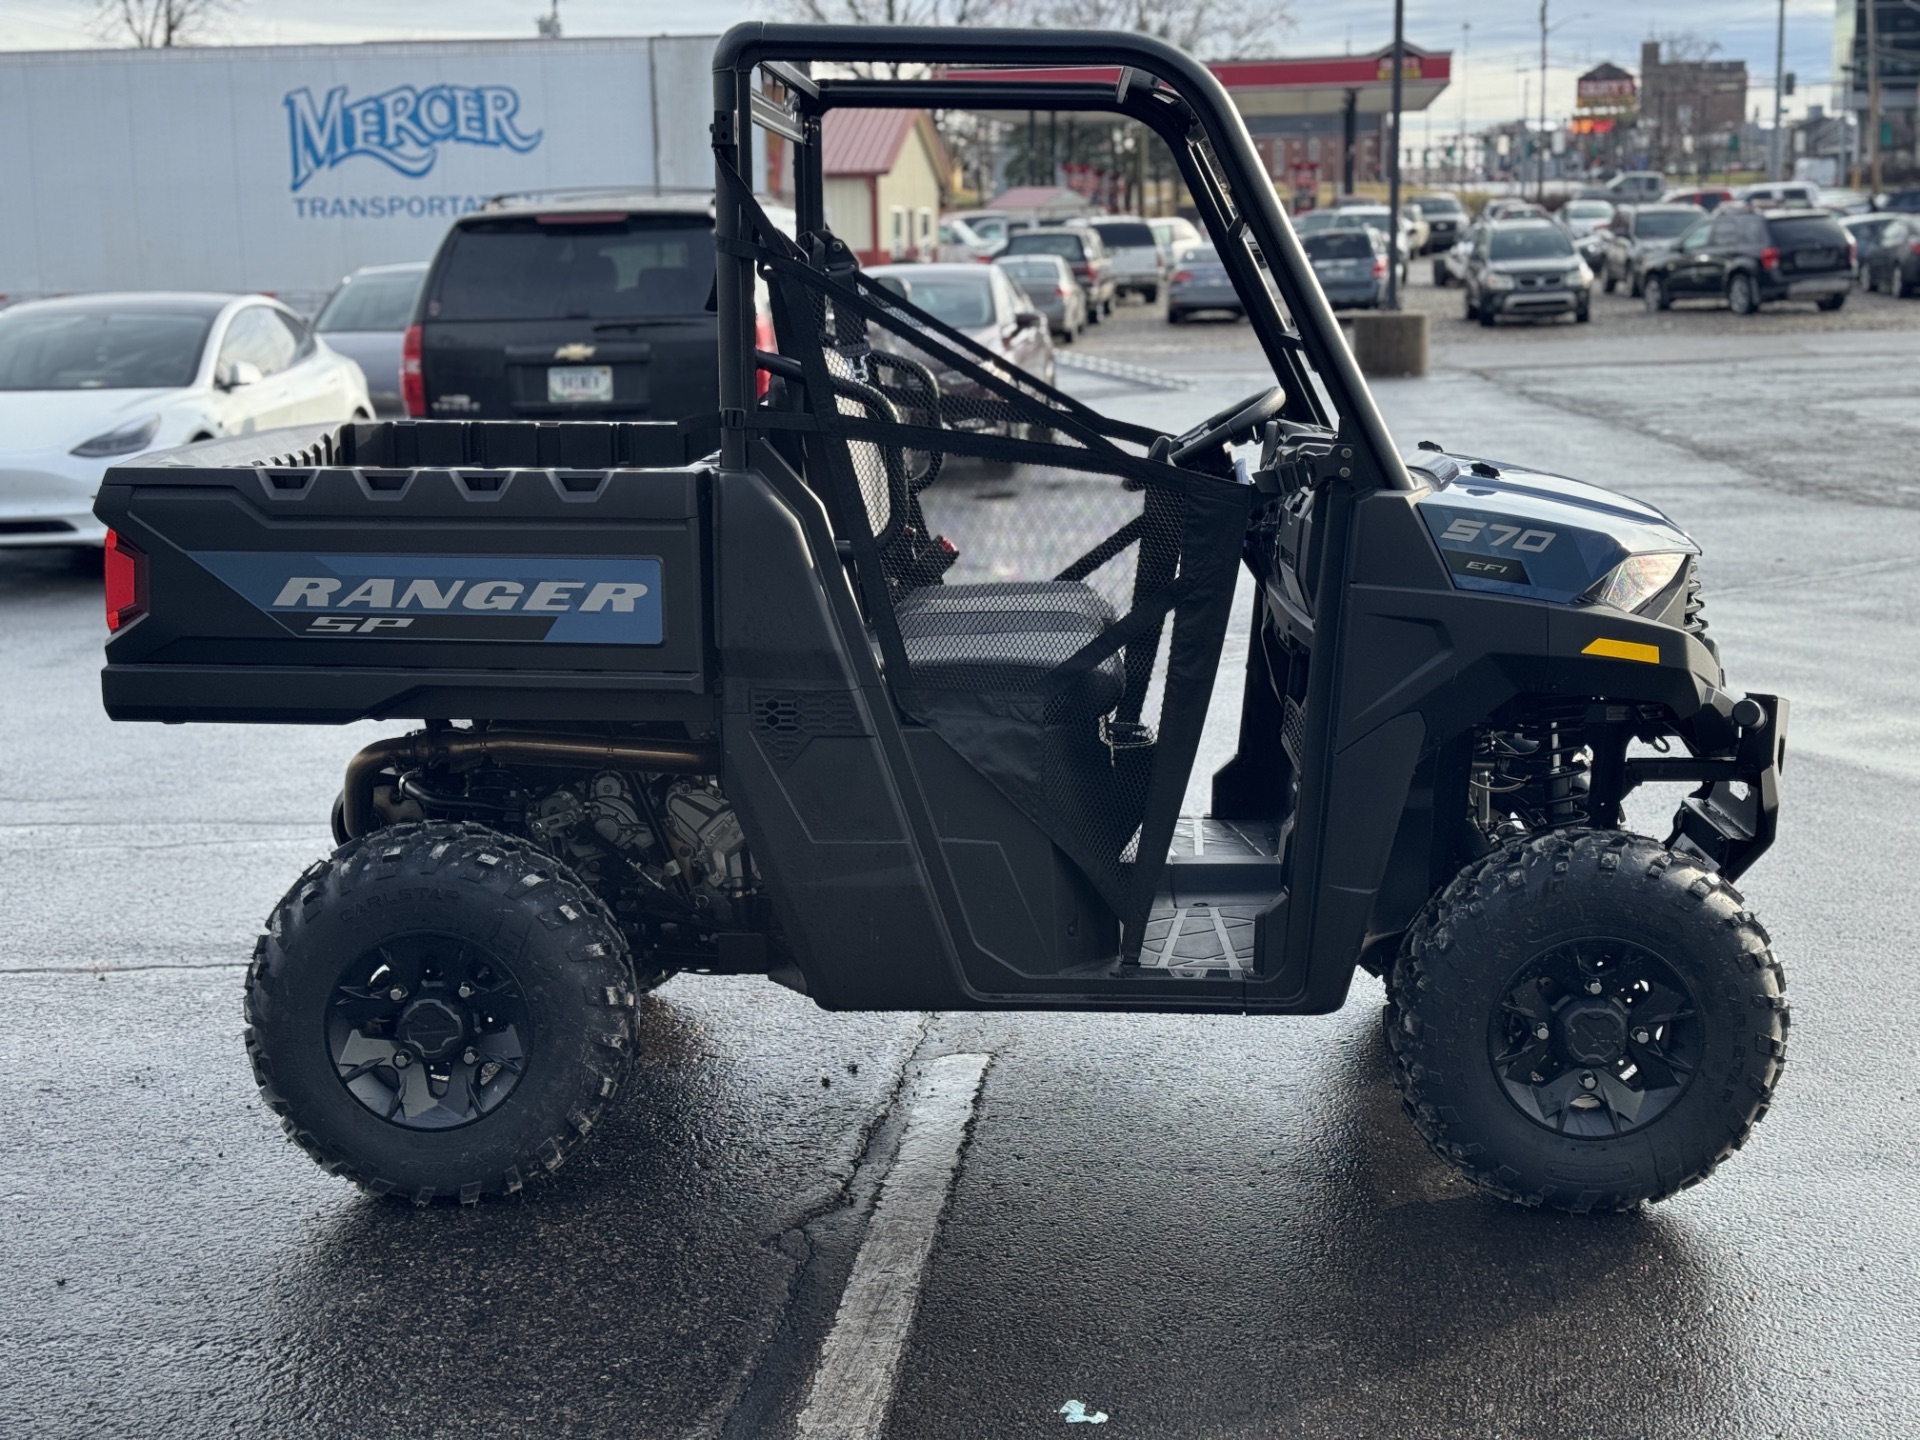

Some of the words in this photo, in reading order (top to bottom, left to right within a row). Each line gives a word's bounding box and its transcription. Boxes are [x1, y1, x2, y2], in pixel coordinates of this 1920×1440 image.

[284, 84, 543, 191] MERCER
[1440, 518, 1556, 552] 570
[1465, 561, 1508, 573] EFI
[272, 577, 648, 613] RANGER
[306, 616, 414, 633] SP
